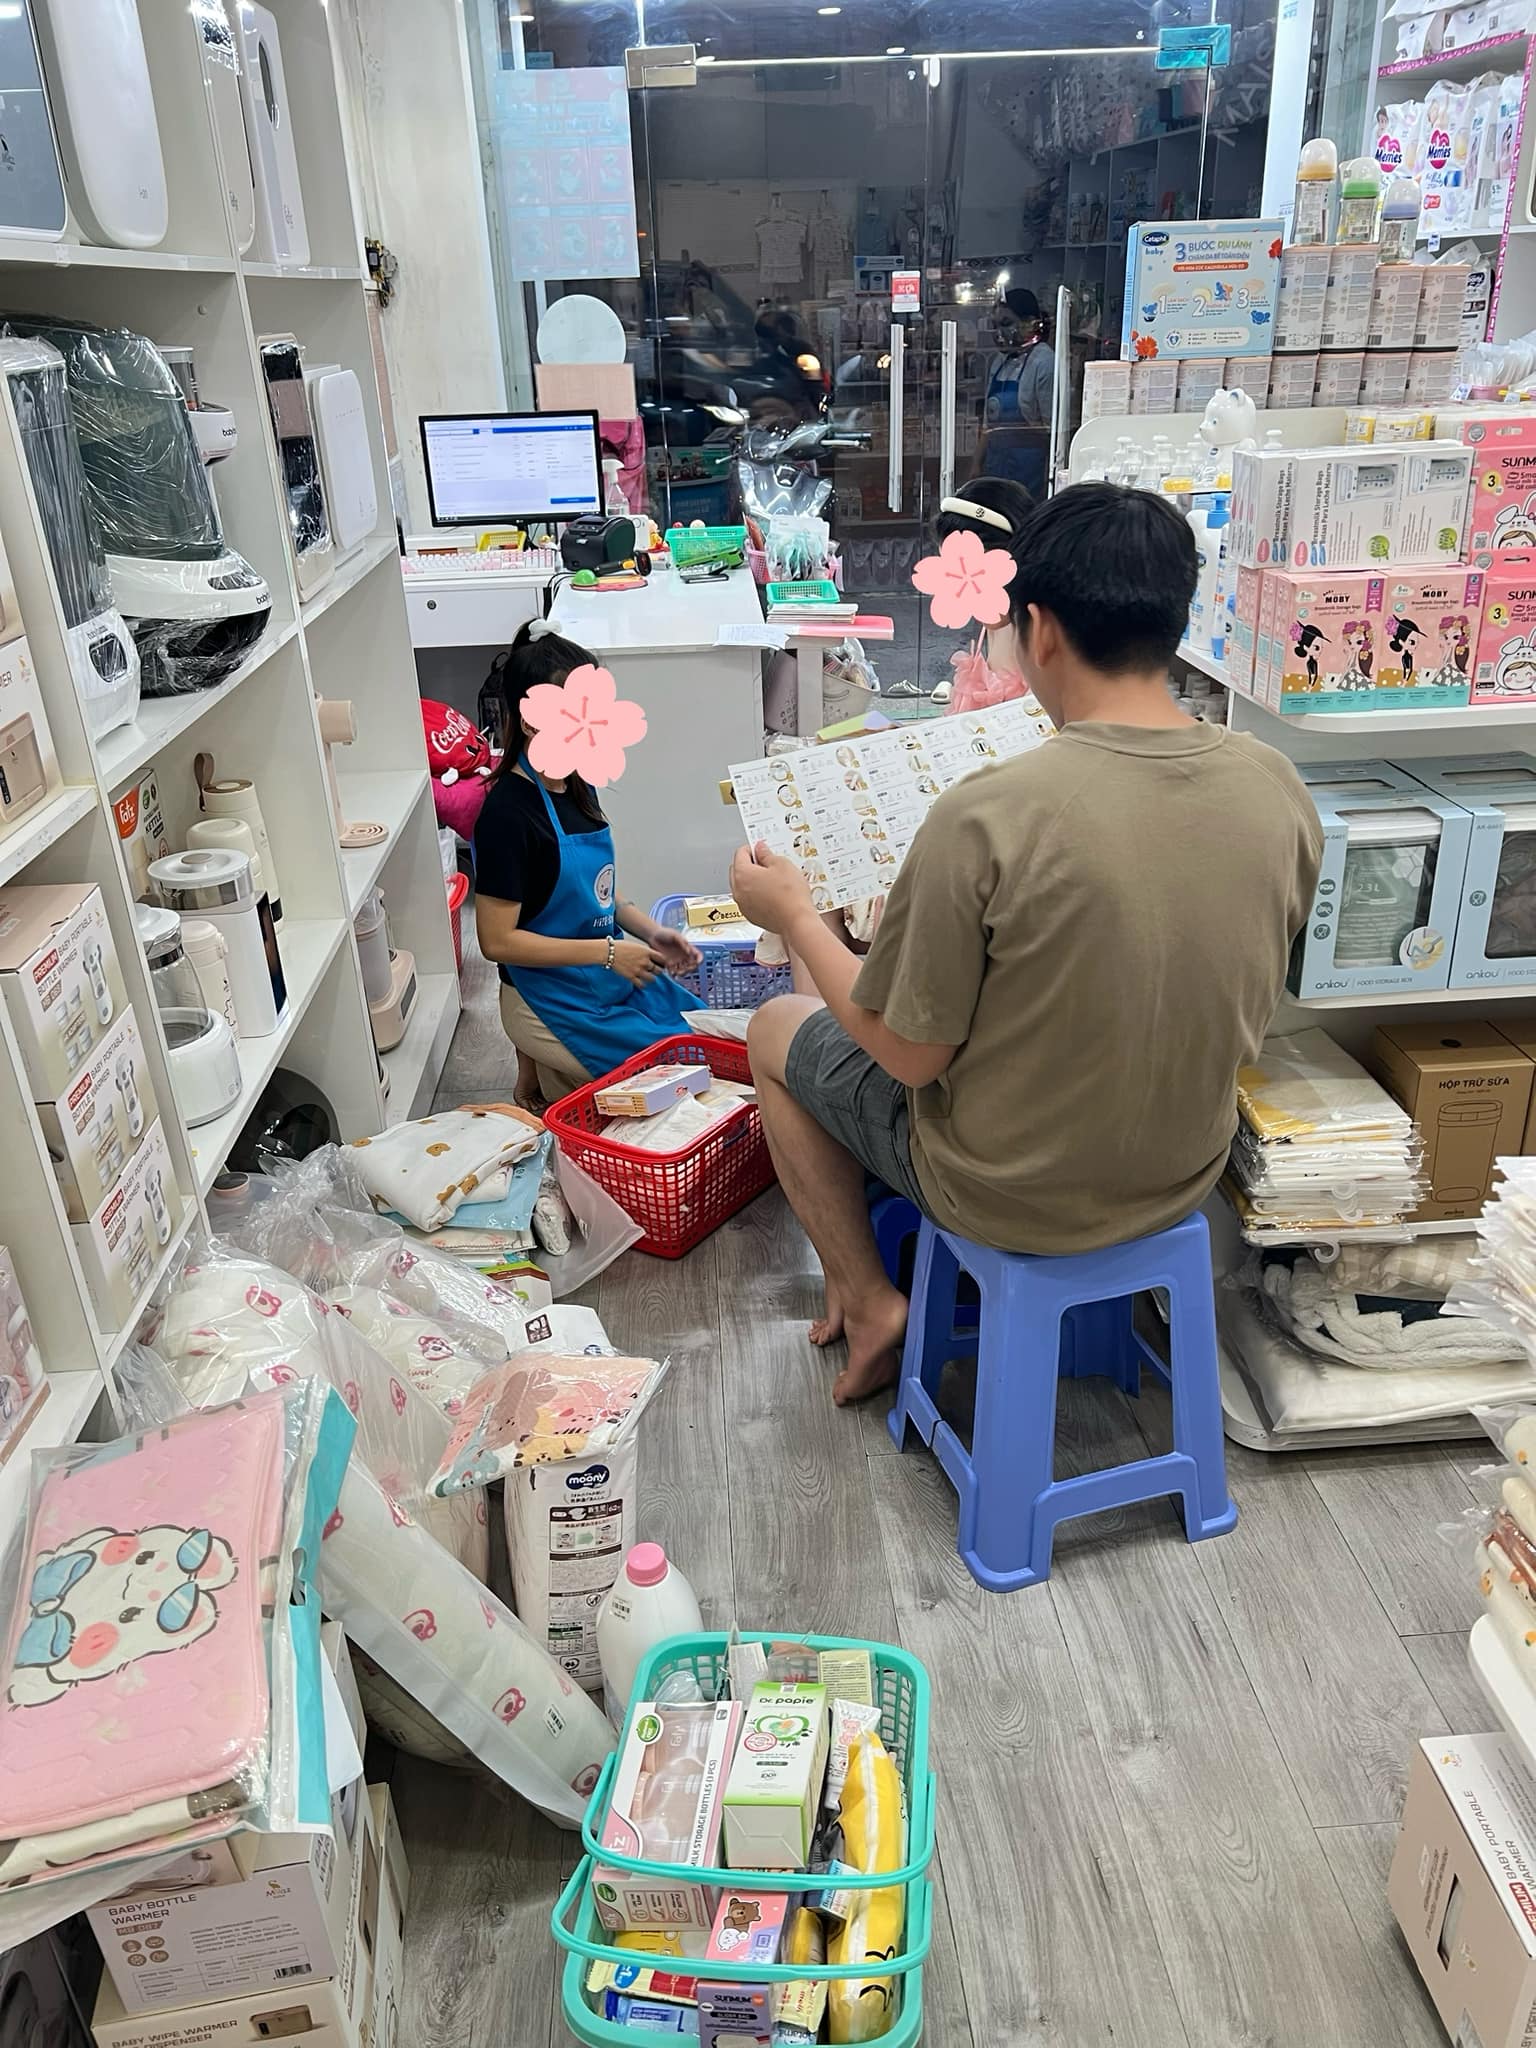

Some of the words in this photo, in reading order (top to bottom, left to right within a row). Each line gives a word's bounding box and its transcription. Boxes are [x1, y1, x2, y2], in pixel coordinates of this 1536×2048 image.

[1375, 149, 1402, 165] Merries
[1427, 145, 1452, 159] Merries
[1144, 234, 1167, 243] Cetaphil
[1175, 242, 1187, 262] 3
[1488, 475, 1496, 487] 3
[1325, 595, 1350, 603] MOBY
[1422, 590, 1449, 598] MOBY
[1494, 607, 1502, 620] 3
[145, 810, 162, 834] KETTLE
[33, 950, 59, 983] PREMIUM
[1315, 980, 1348, 990] ankou
[1439, 1079, 1461, 1090] HỘP
[1462, 1077, 1486, 1089] TRỮ
[1487, 1076, 1511, 1087] SỮA
[69, 1074, 92, 1109] PREMIUM
[568, 1470, 608, 1485] moony
[694, 1812, 706, 1848] STORAGE
[700, 1781, 713, 1812] BOTTLES
[1464, 1789, 1499, 1846] PORTABLE
[1494, 1849, 1518, 1880] BABY
[108, 1903, 143, 1916] BABY
[146, 1893, 198, 1910] BOTTLE
[111, 1909, 170, 1926] WARMER
[714, 1994, 752, 2004] SUNMUM
[112, 2035, 146, 2048] BABY
[148, 2029, 181, 2043] WIPE
[183, 2019, 239, 2037] WARMER
